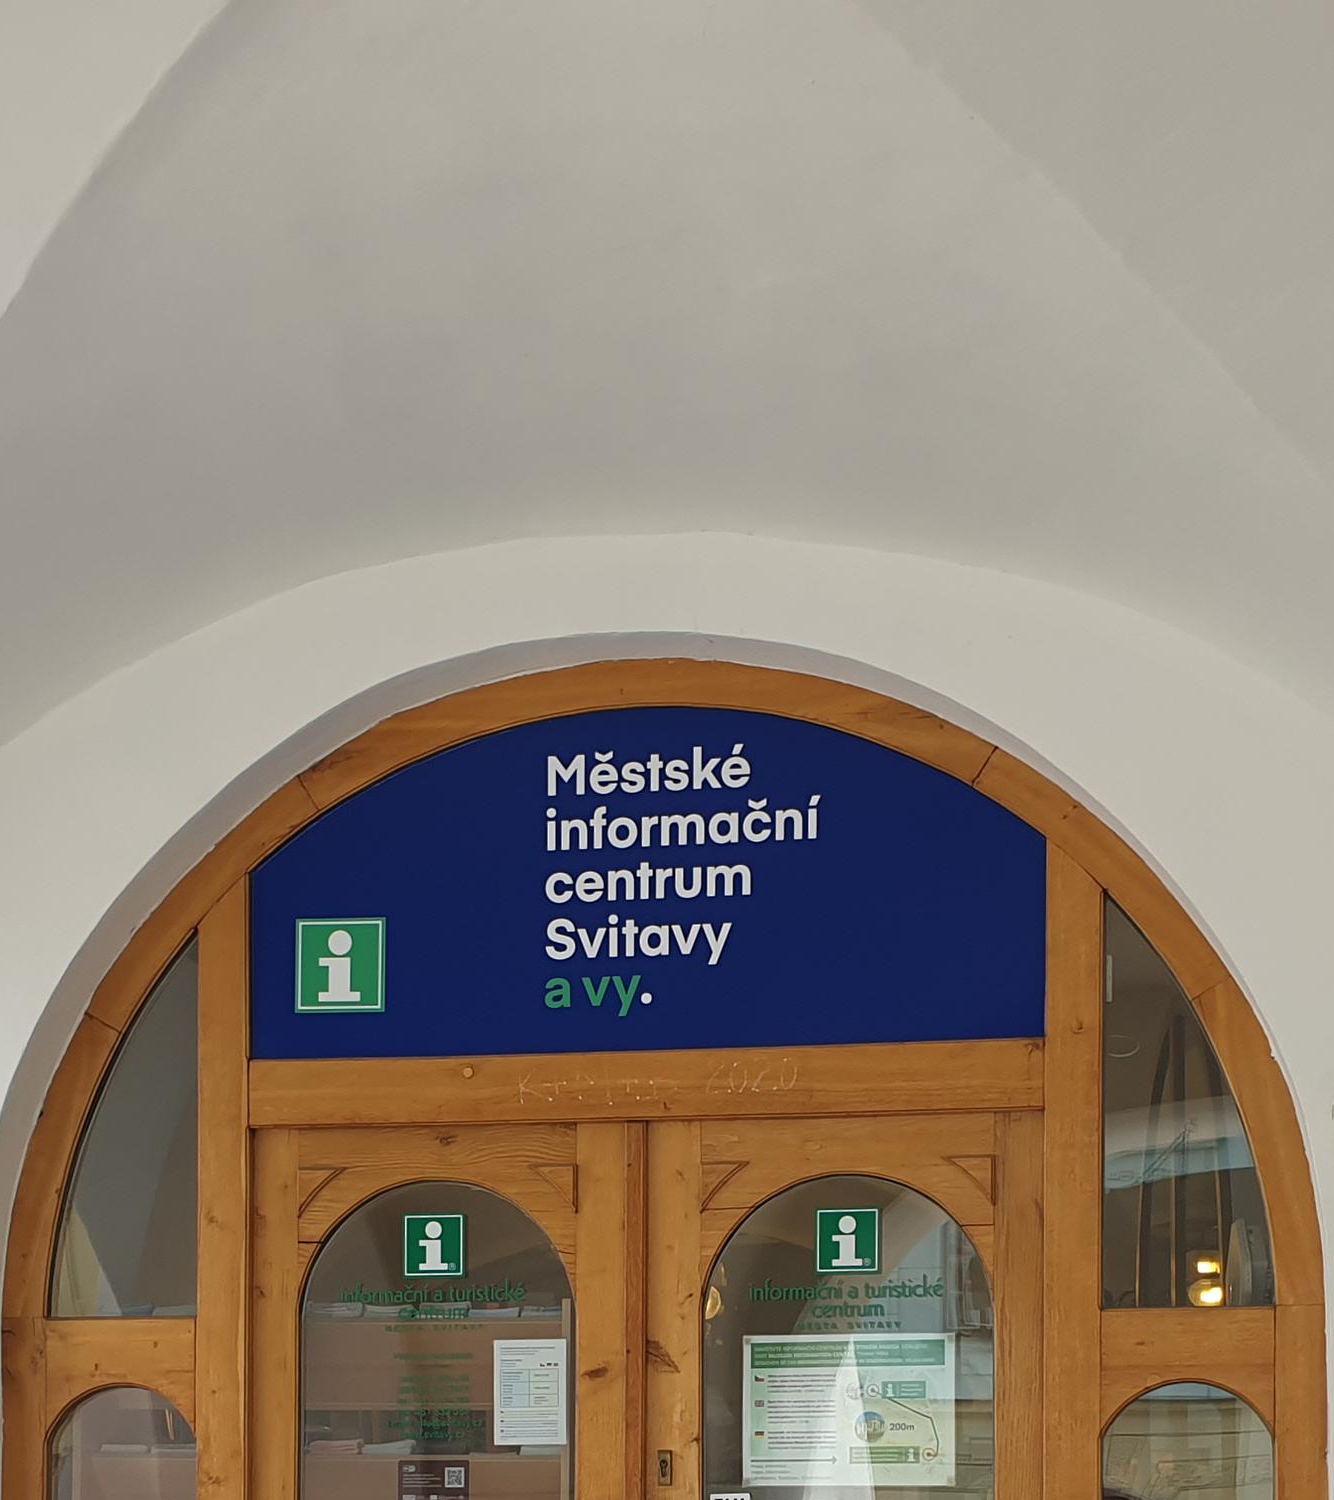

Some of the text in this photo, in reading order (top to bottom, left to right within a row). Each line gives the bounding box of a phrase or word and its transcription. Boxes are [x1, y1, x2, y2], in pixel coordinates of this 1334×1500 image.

[546, 743, 751, 797] Městské
[546, 794, 821, 851] informační
[545, 861, 752, 904] centrum
[545, 914, 732, 965] Svitavy
[544, 975, 653, 1017] a vy.
[340, 1278, 527, 1302] informační a turistické
[748, 1274, 944, 1302] informační a turistické
[812, 1302, 885, 1319] centrum
[889, 1422, 915, 1431] 200m
